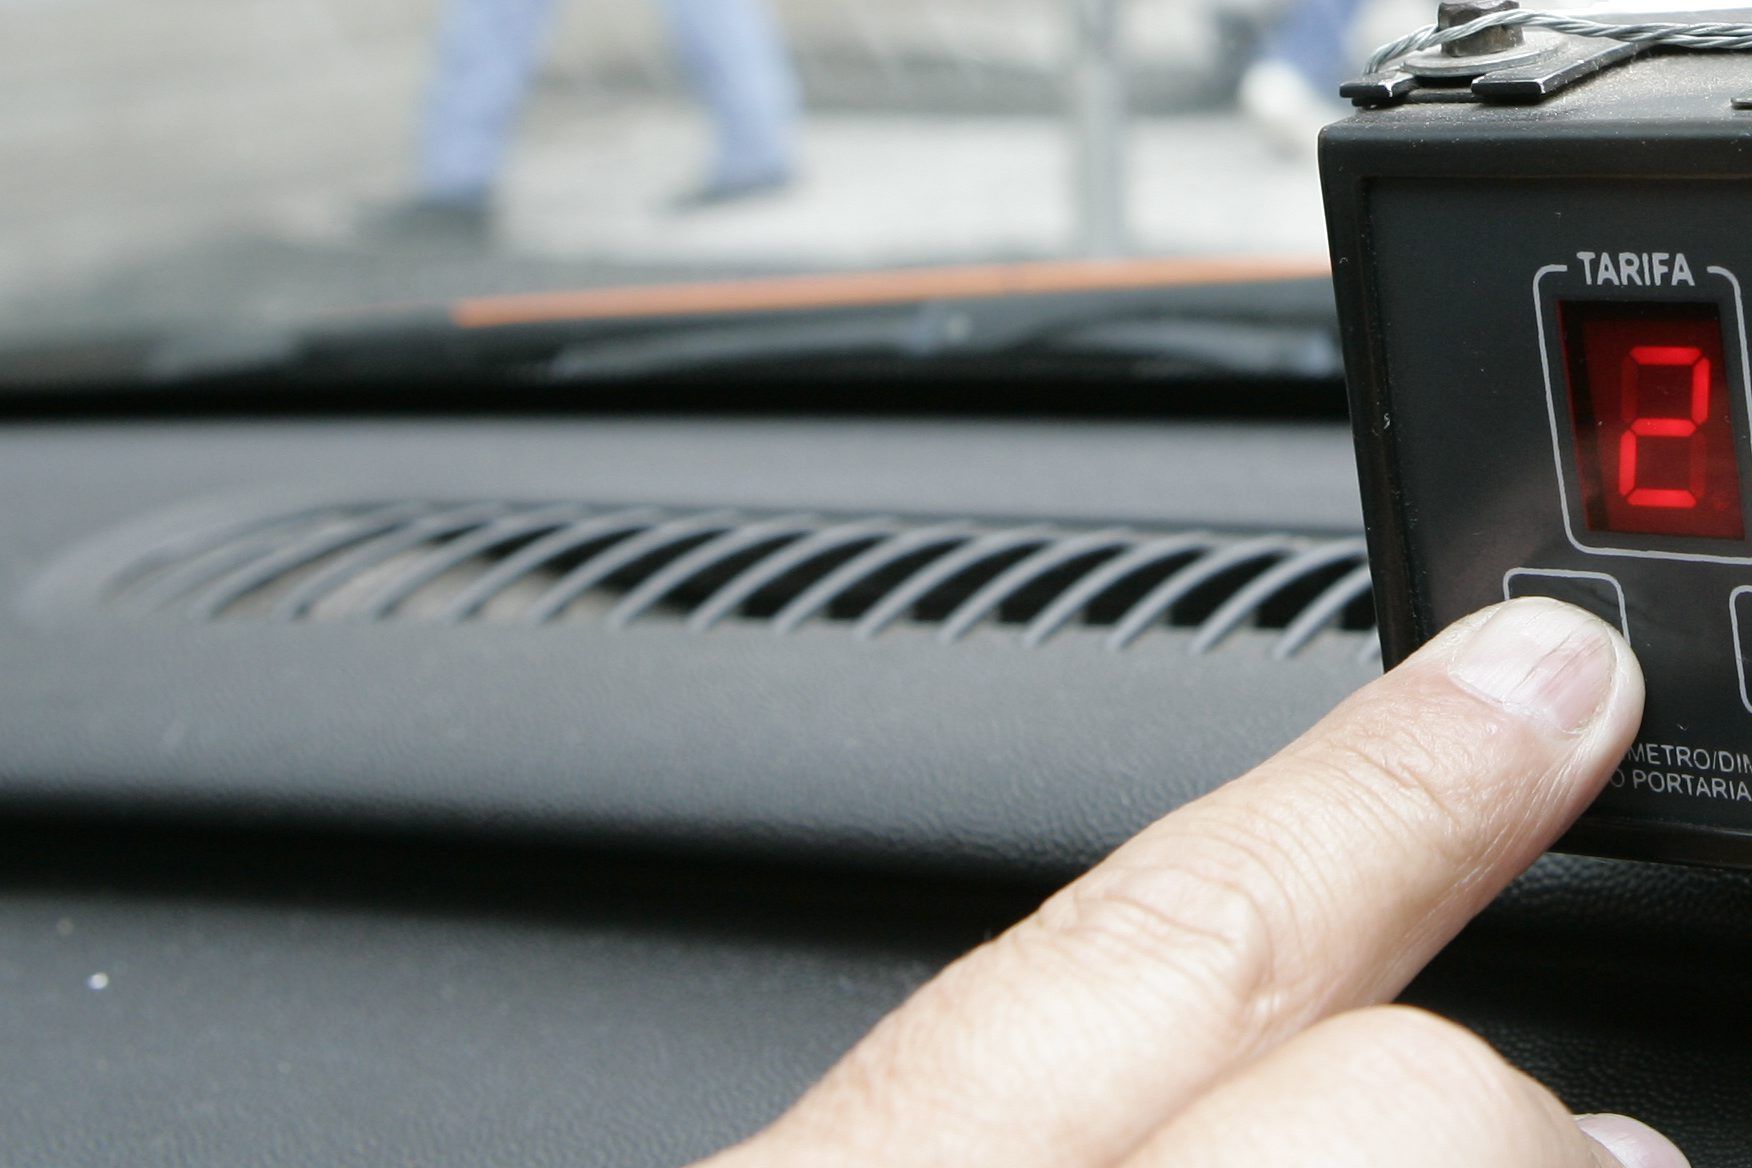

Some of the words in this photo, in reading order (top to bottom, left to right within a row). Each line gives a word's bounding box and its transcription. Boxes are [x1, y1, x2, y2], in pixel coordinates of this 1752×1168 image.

[1575, 250, 1697, 287] TARIFA
[1617, 345, 1712, 509] 2
[1632, 769, 1752, 802] PORTARIA
